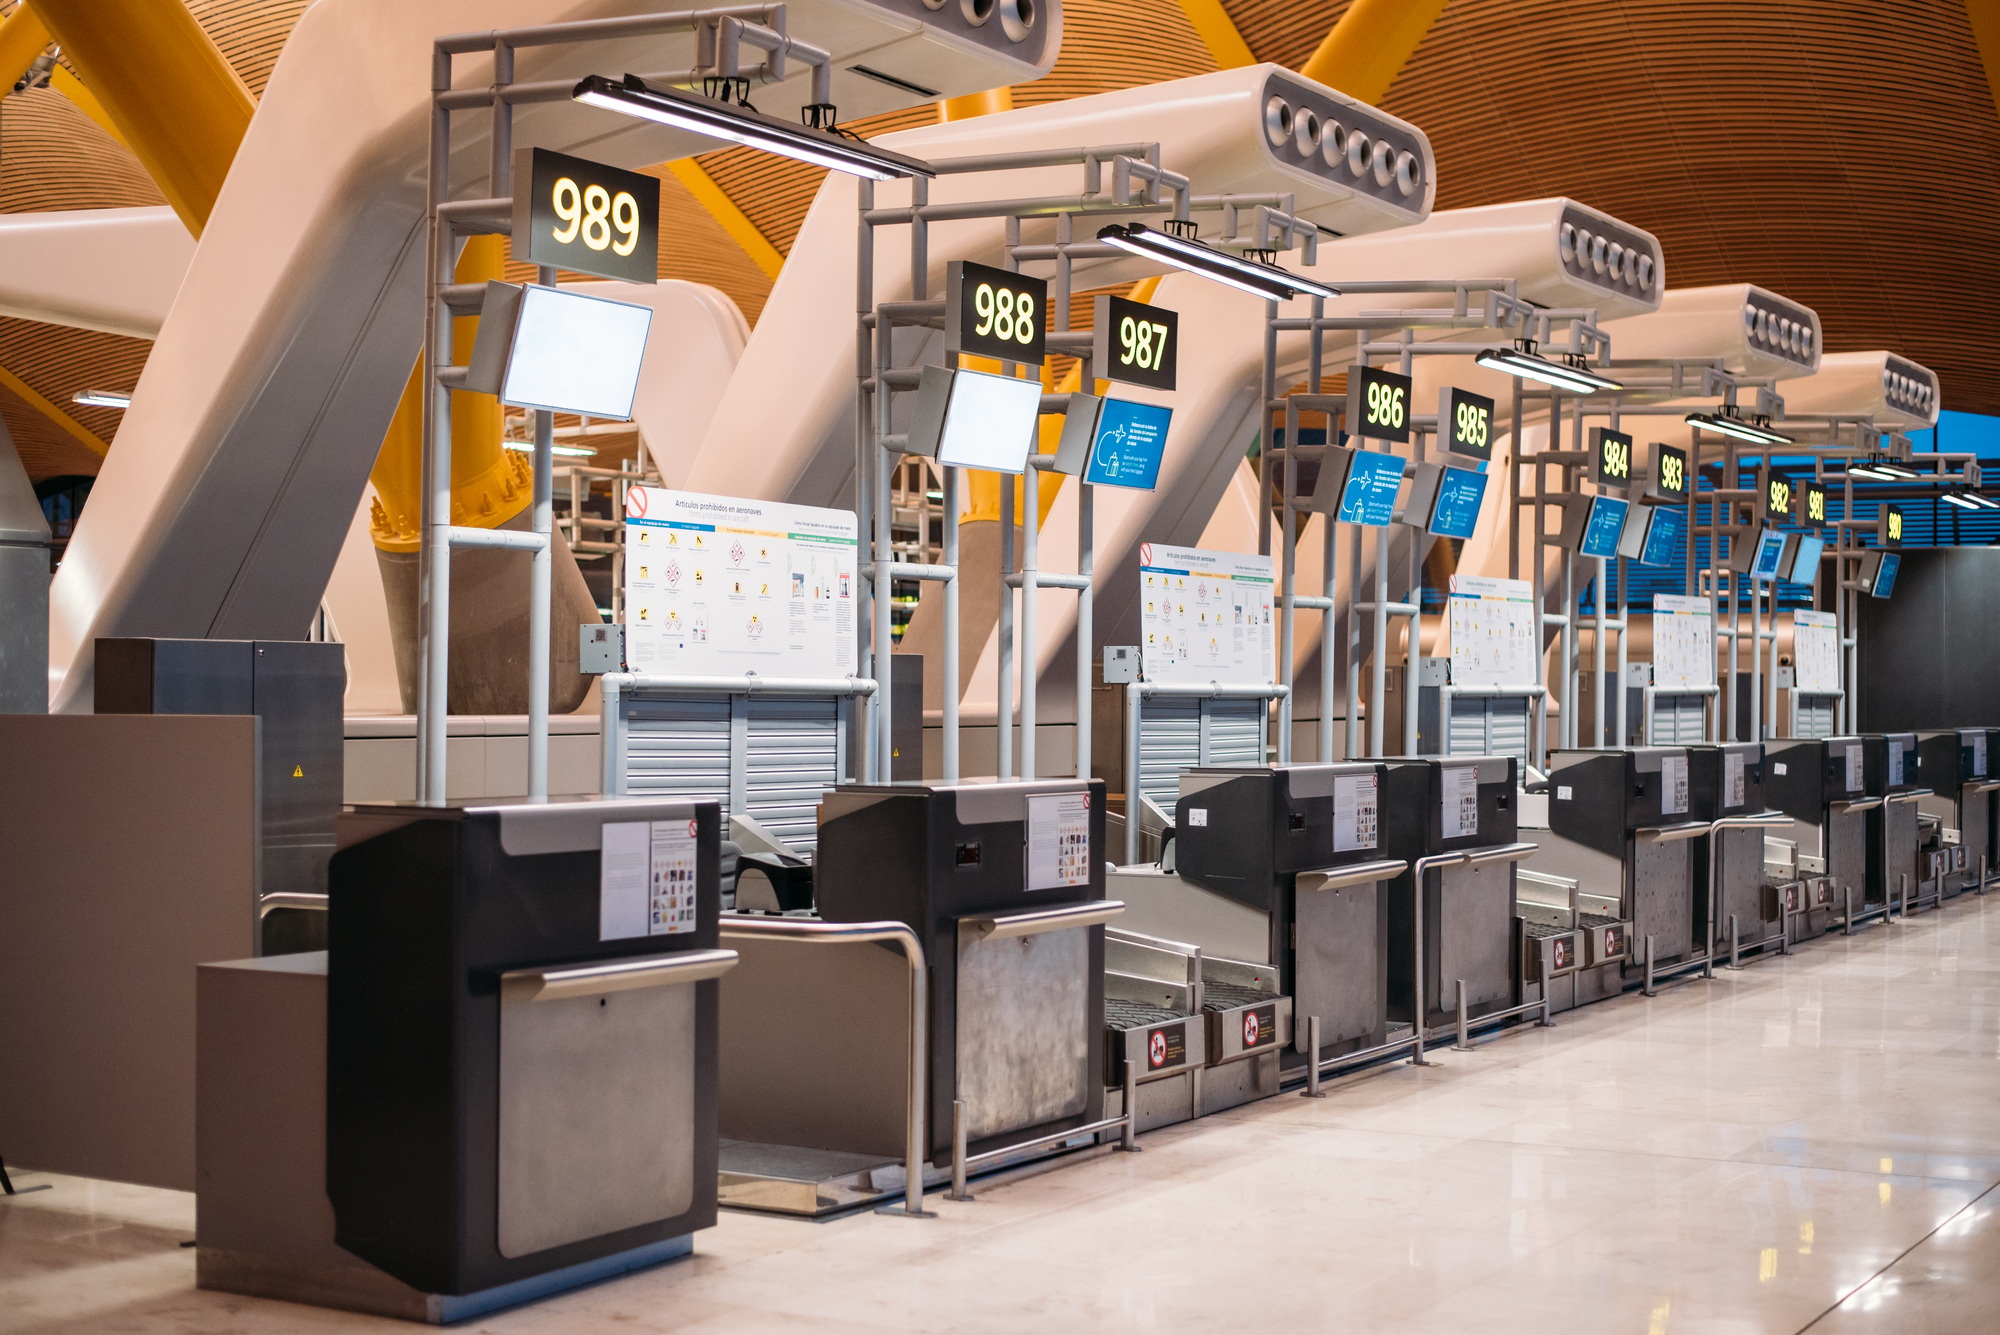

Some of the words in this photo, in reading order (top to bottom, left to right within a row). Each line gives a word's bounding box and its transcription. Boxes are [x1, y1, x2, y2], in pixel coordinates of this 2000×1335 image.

[551, 176, 640, 258] 989
[974, 283, 1035, 345] 988
[1120, 316, 1168, 371] 987
[1367, 381, 1405, 429] 986
[1456, 402, 1488, 448] 985
[1603, 439, 1629, 479] 984
[1661, 454, 1683, 492] 983
[700, 502, 727, 513] prohibidos
[728, 505, 735, 513] en
[736, 507, 762, 516] aeronaves
[1770, 480, 1789, 514] 982
[1808, 489, 1824, 521] 981
[1888, 512, 1902, 541] 980
